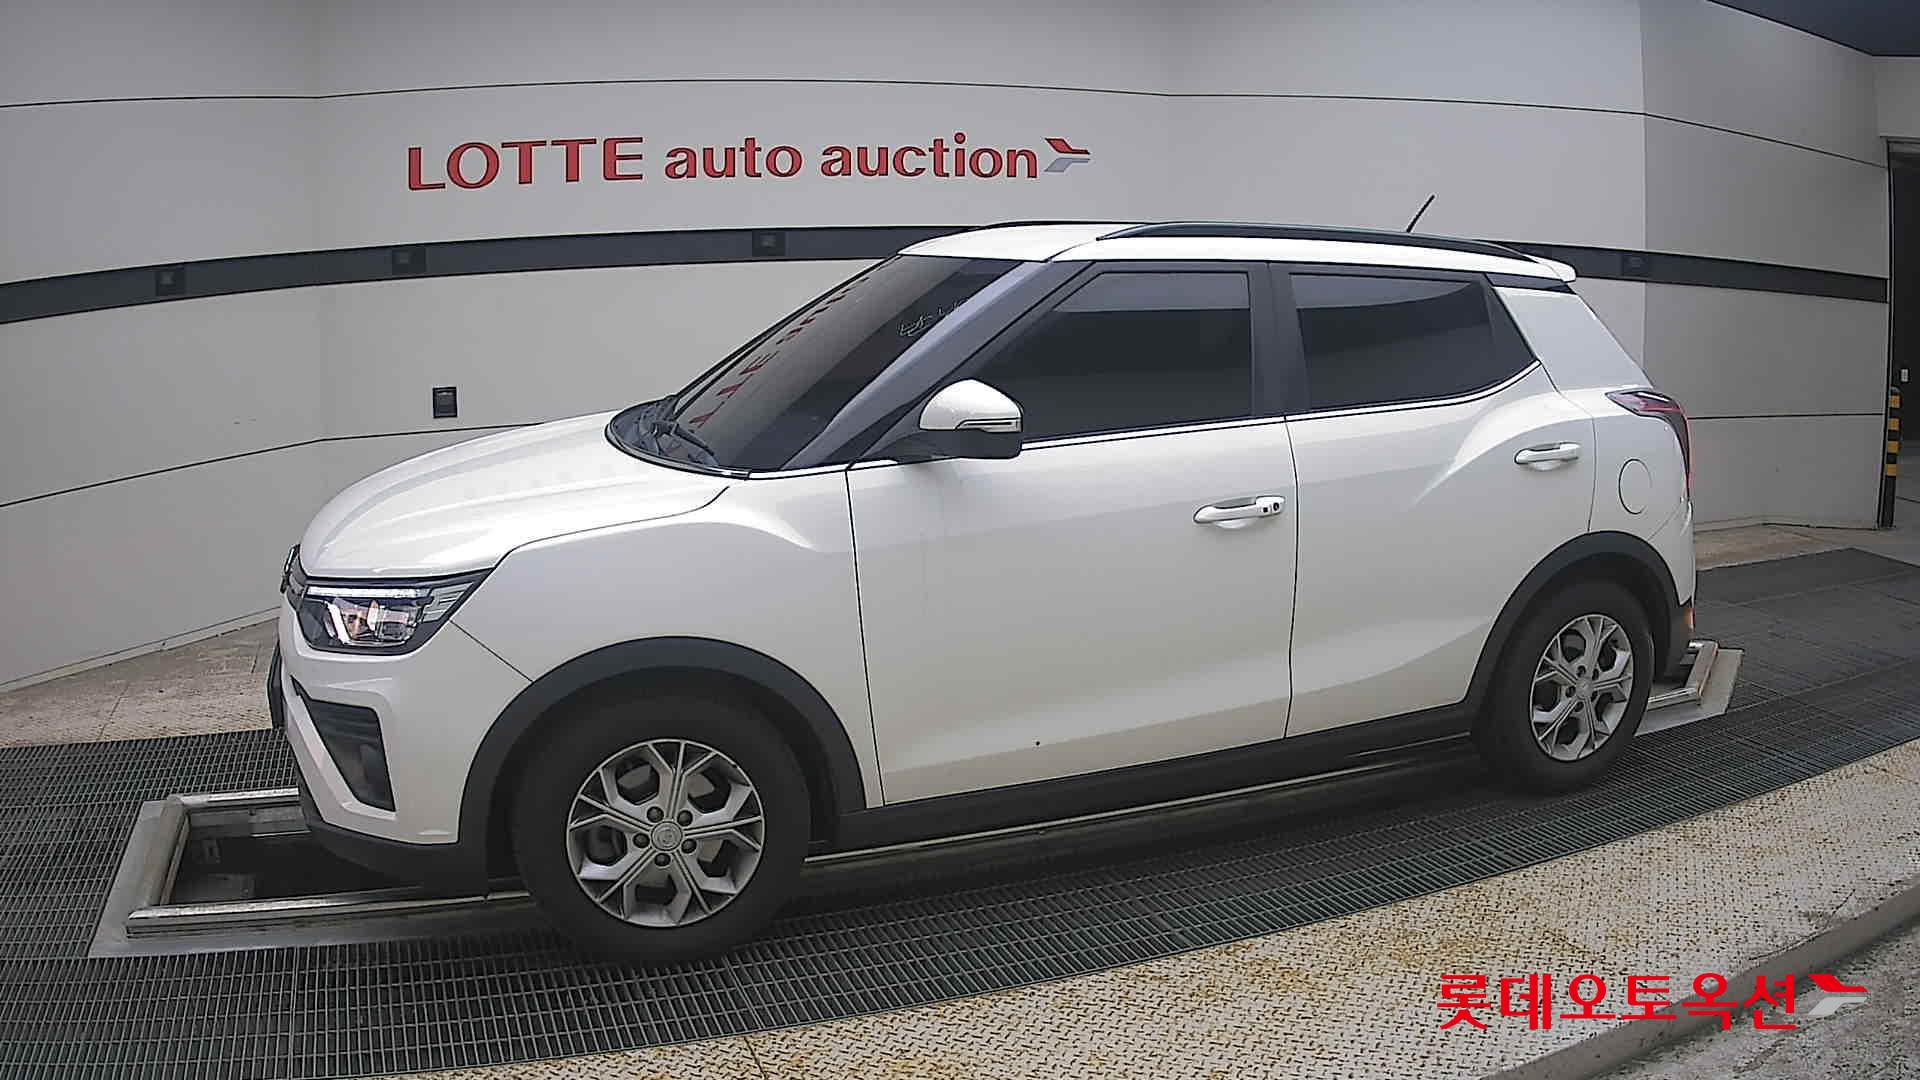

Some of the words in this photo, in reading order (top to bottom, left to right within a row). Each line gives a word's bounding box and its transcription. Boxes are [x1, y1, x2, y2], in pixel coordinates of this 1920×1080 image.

[408, 136, 644, 191] LOTTE
[664, 137, 803, 179] auto
[821, 132, 1039, 178] auction
